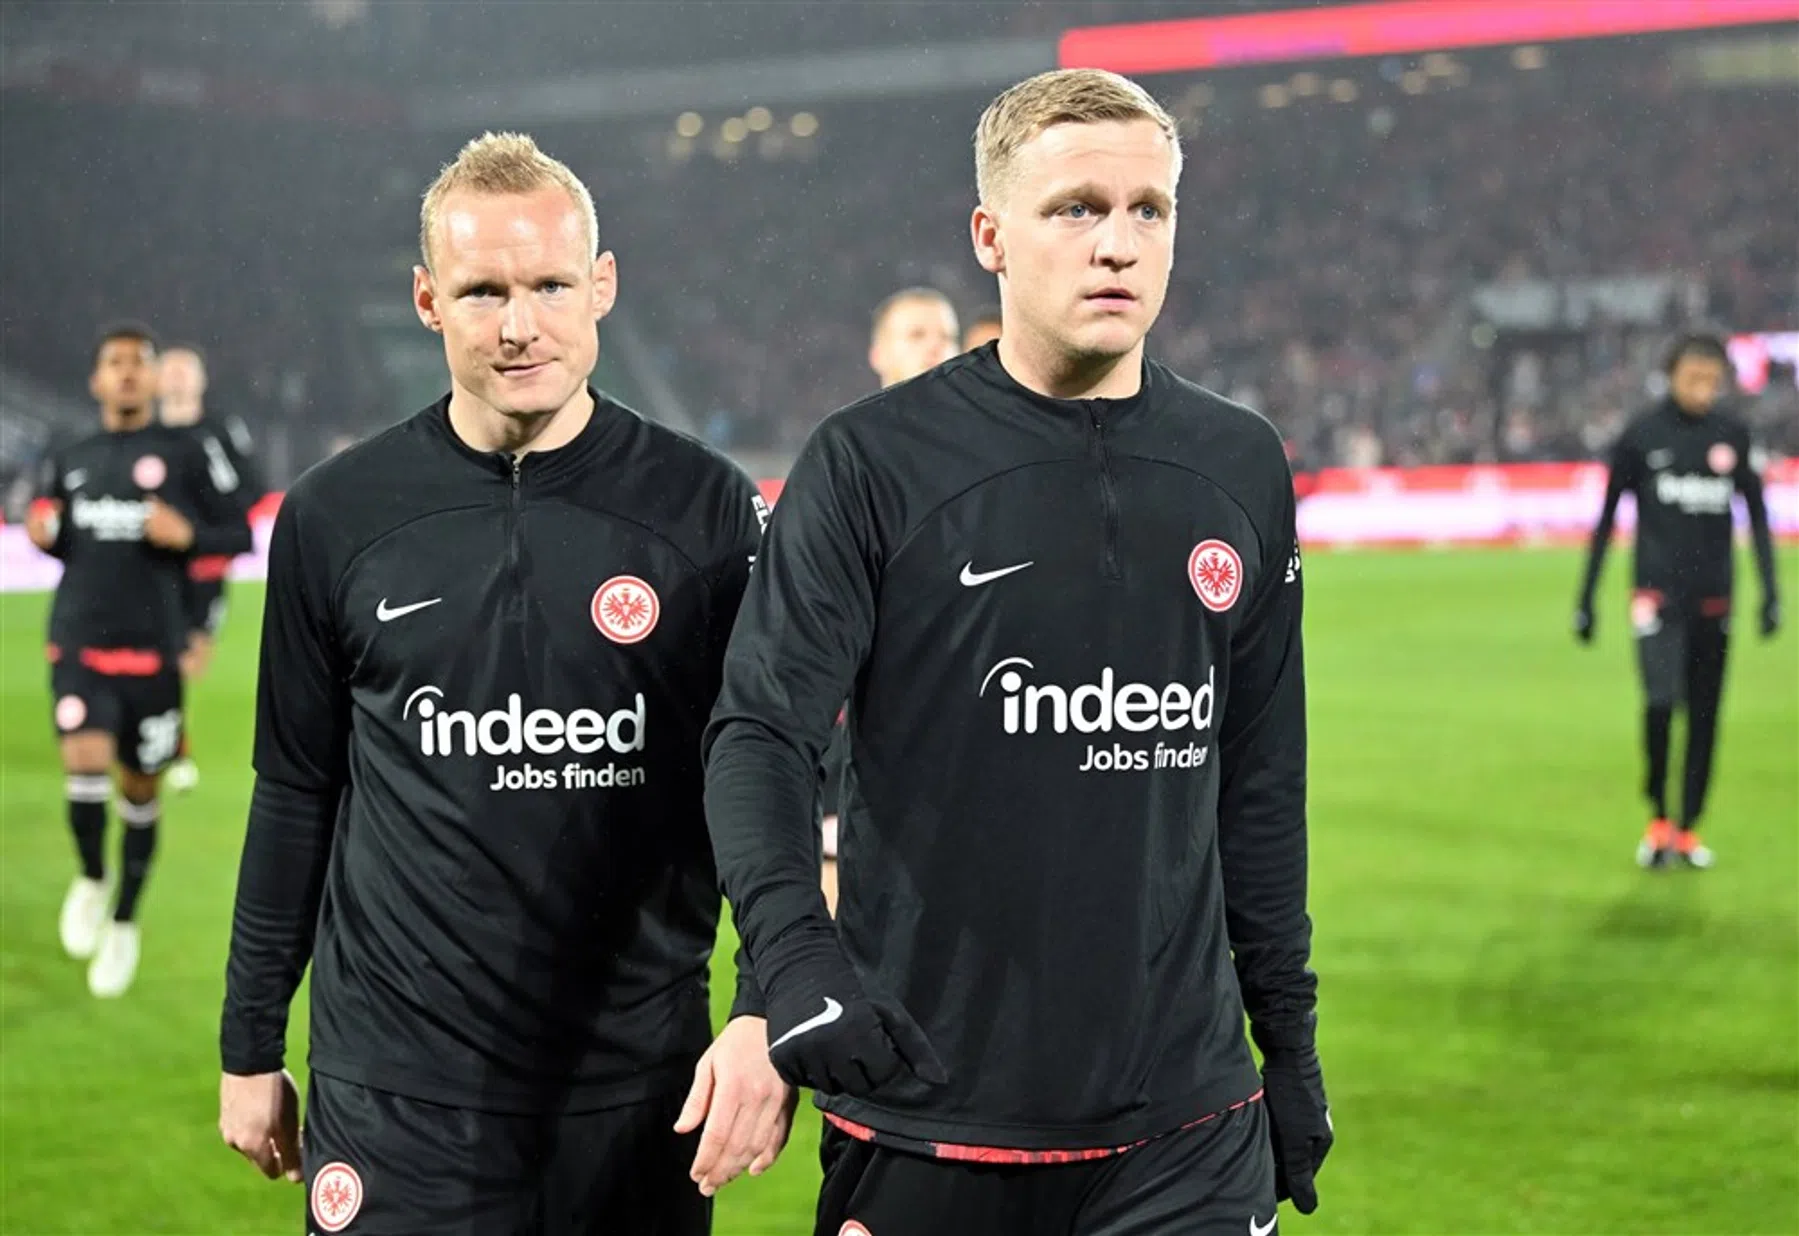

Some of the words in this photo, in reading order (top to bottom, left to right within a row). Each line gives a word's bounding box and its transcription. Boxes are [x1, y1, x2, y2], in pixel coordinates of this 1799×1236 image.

[1000, 664, 1215, 734] indeed
[417, 692, 646, 757] indeed
[489, 762, 558, 791] Jobs
[561, 762, 646, 790] finden
[1079, 743, 1150, 771] Jobs
